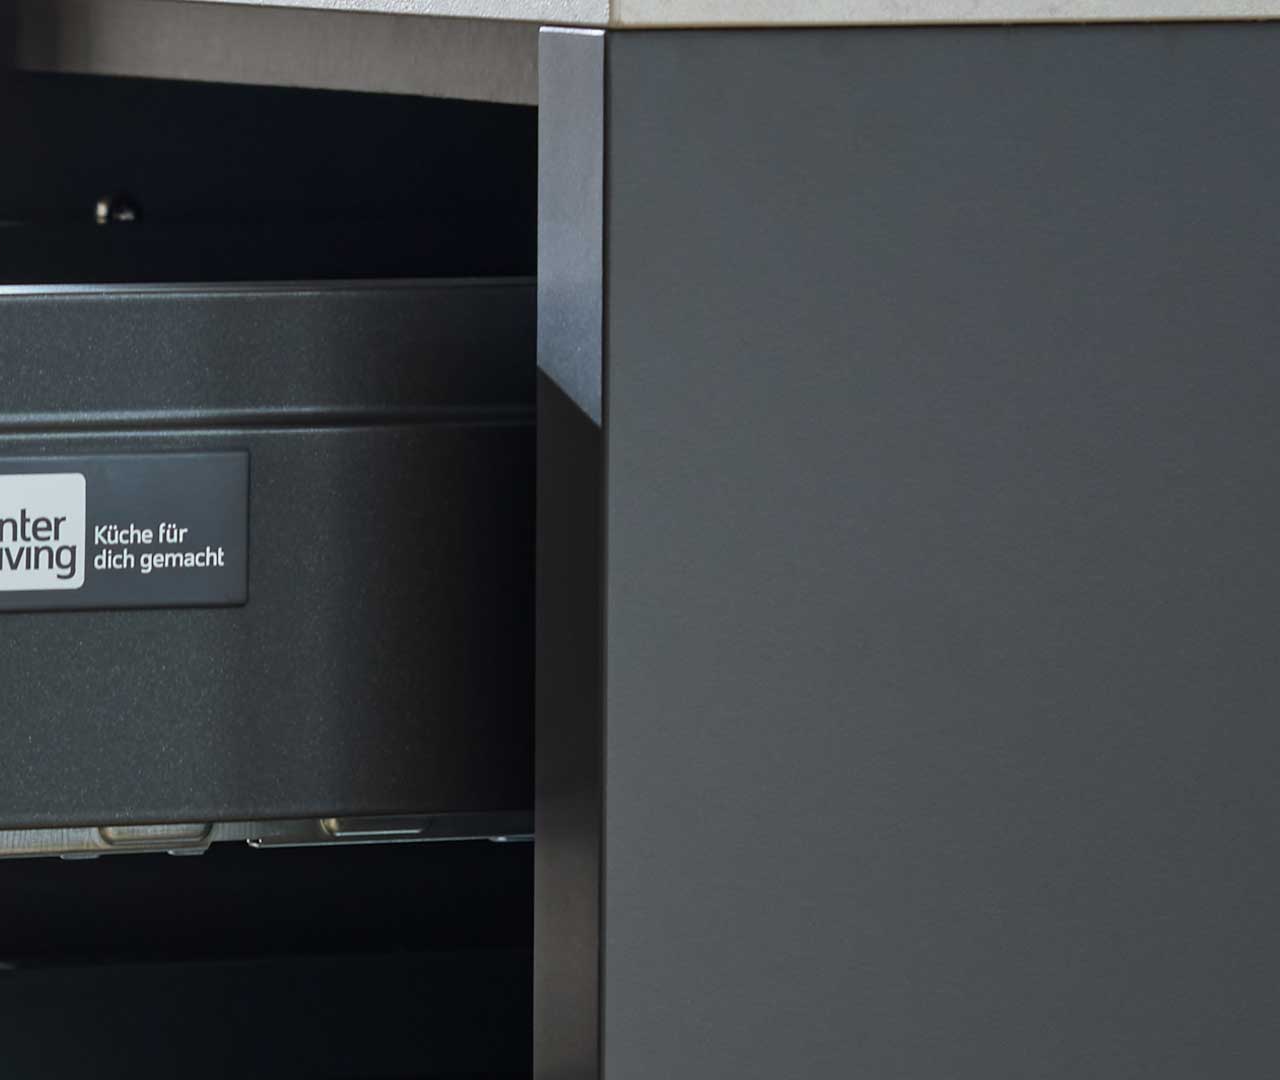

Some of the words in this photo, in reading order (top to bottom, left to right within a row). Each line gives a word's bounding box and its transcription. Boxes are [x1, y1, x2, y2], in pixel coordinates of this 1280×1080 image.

[94, 523, 153, 545] Küche
[158, 523, 188, 544] für
[94, 549, 135, 570] dich
[140, 546, 224, 573] gemacht
